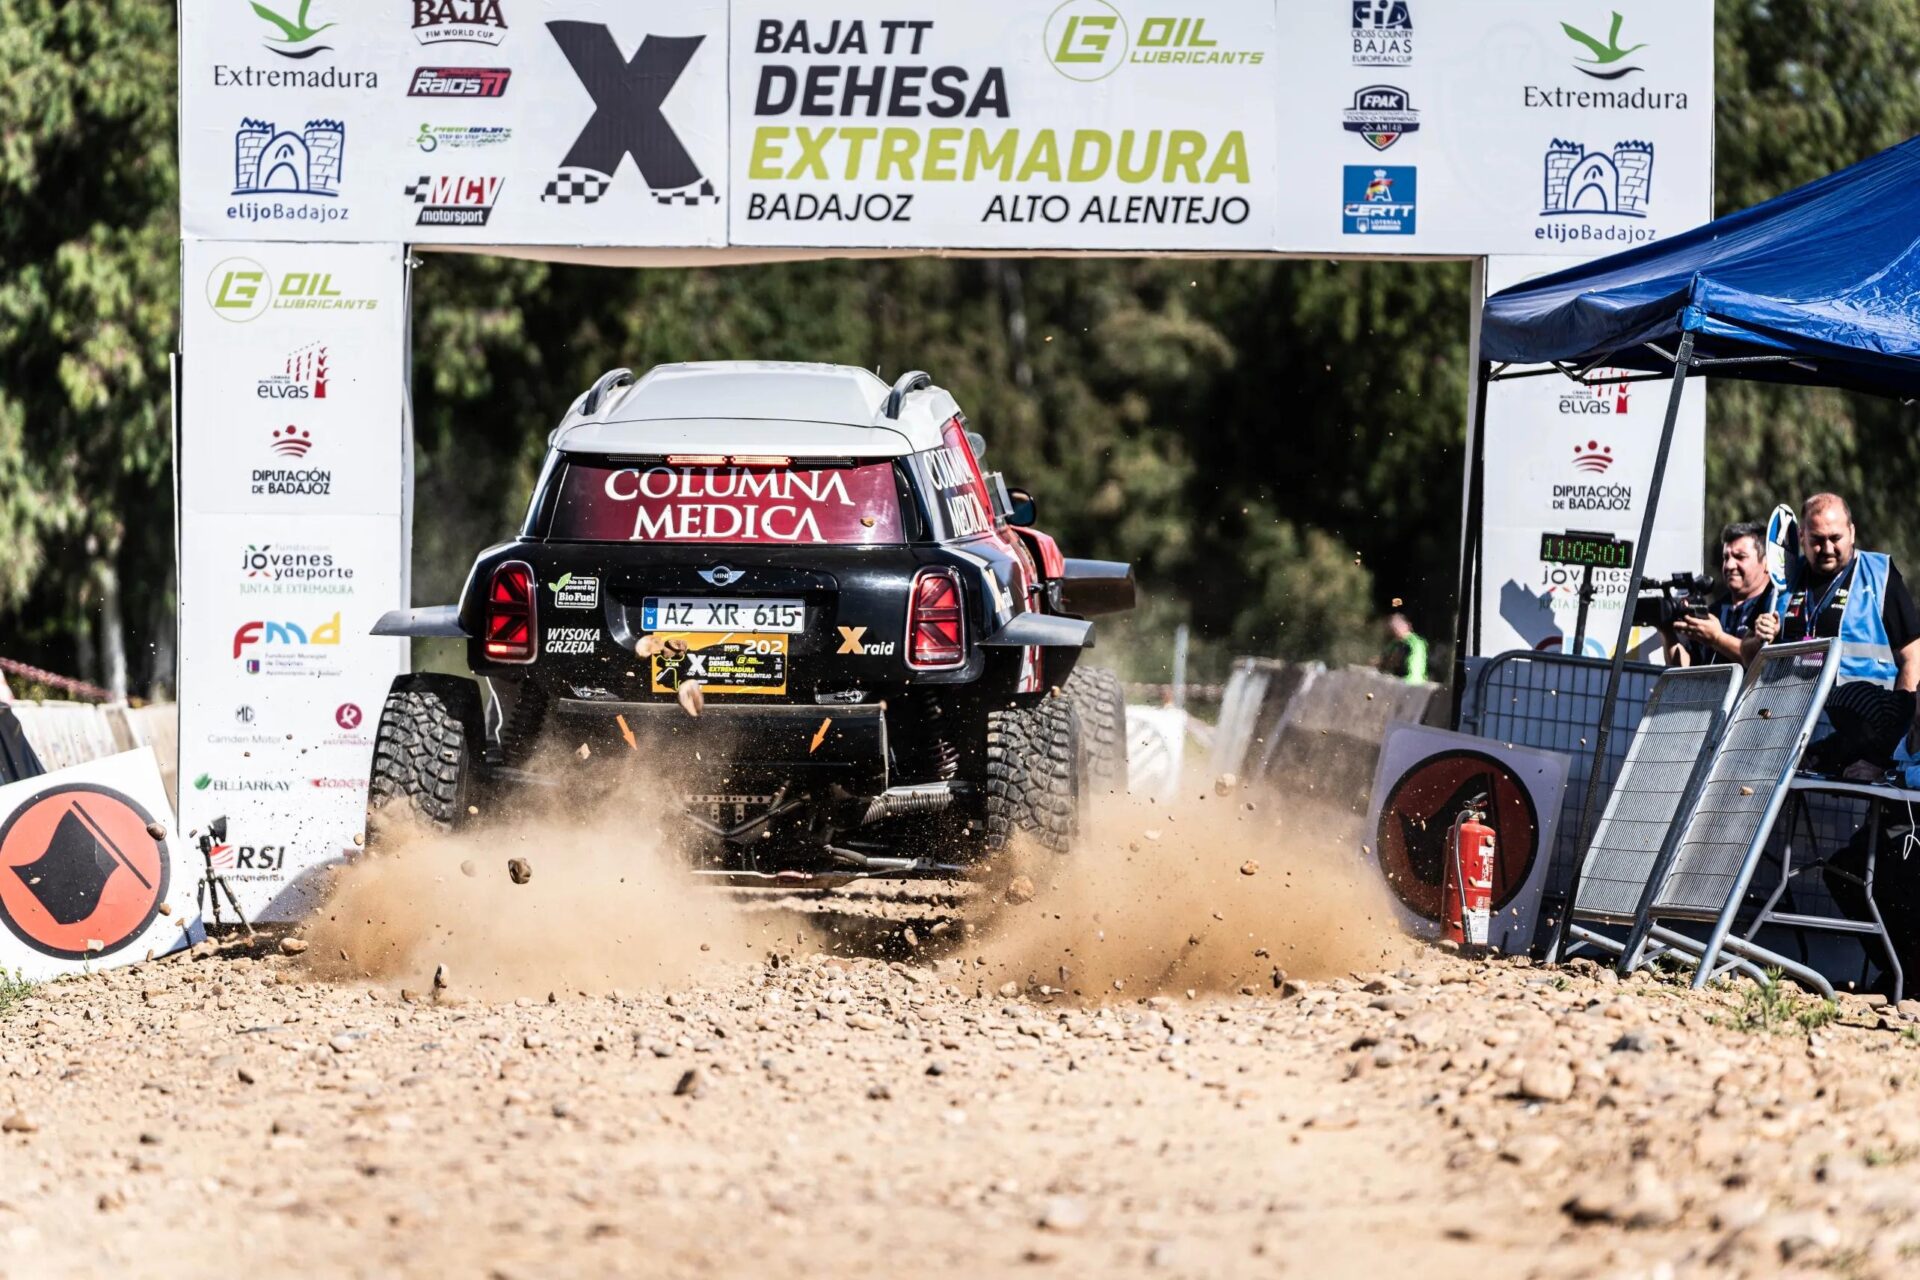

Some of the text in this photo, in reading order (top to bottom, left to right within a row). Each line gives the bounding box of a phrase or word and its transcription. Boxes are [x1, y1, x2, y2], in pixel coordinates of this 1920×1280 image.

[411, 0, 509, 29] BAJA
[425, 29, 494, 38] FIM WORLD CUP
[754, 19, 934, 55] BAJA TT
[1136, 16, 1218, 47] OIL
[1351, 30, 1413, 39] CROSS COUNTRY
[1353, 39, 1412, 54] BAJAS
[1130, 51, 1265, 65] LUBRICANTS
[1352, 55, 1412, 63] EUROPEAN CUP
[213, 65, 378, 89] Extremadura
[754, 65, 1011, 118] DEHESA
[1523, 86, 1688, 109] Extremadura
[1363, 95, 1399, 108] FPAK
[748, 126, 1251, 184] EXTREMADURA
[227, 202, 350, 223] elijoBadajoz
[422, 209, 483, 224] motorsport
[746, 193, 1251, 225] BADAJOZ ALTO ALENTEJO
[1534, 223, 1656, 243] elijoBadajoz
[278, 273, 342, 296] OIL
[272, 299, 378, 310] LUBRICANTS
[252, 467, 330, 482] DIPUTACIÓN
[252, 483, 330, 495] DE BADAJOZ
[604, 466, 856, 507] COLUMNA
[1553, 483, 1631, 498] DIPUTACIÓN
[1553, 499, 1631, 511] DE BADAJOZ
[630, 504, 827, 543] MEDICA
[1543, 538, 1627, 567] 11:05:01
[240, 583, 354, 595] JUNTA DE EXTREMADURA
[558, 592, 595, 601] Bio Fuel
[647, 617, 654, 625] D
[665, 603, 797, 628] AZ XR 615
[233, 611, 341, 660] fmd
[547, 628, 600, 642] WYSOKA
[837, 626, 894, 655] Xraid
[545, 642, 595, 655] GRZĘDA
[744, 640, 784, 655] 202
[236, 845, 286, 869] RSI
